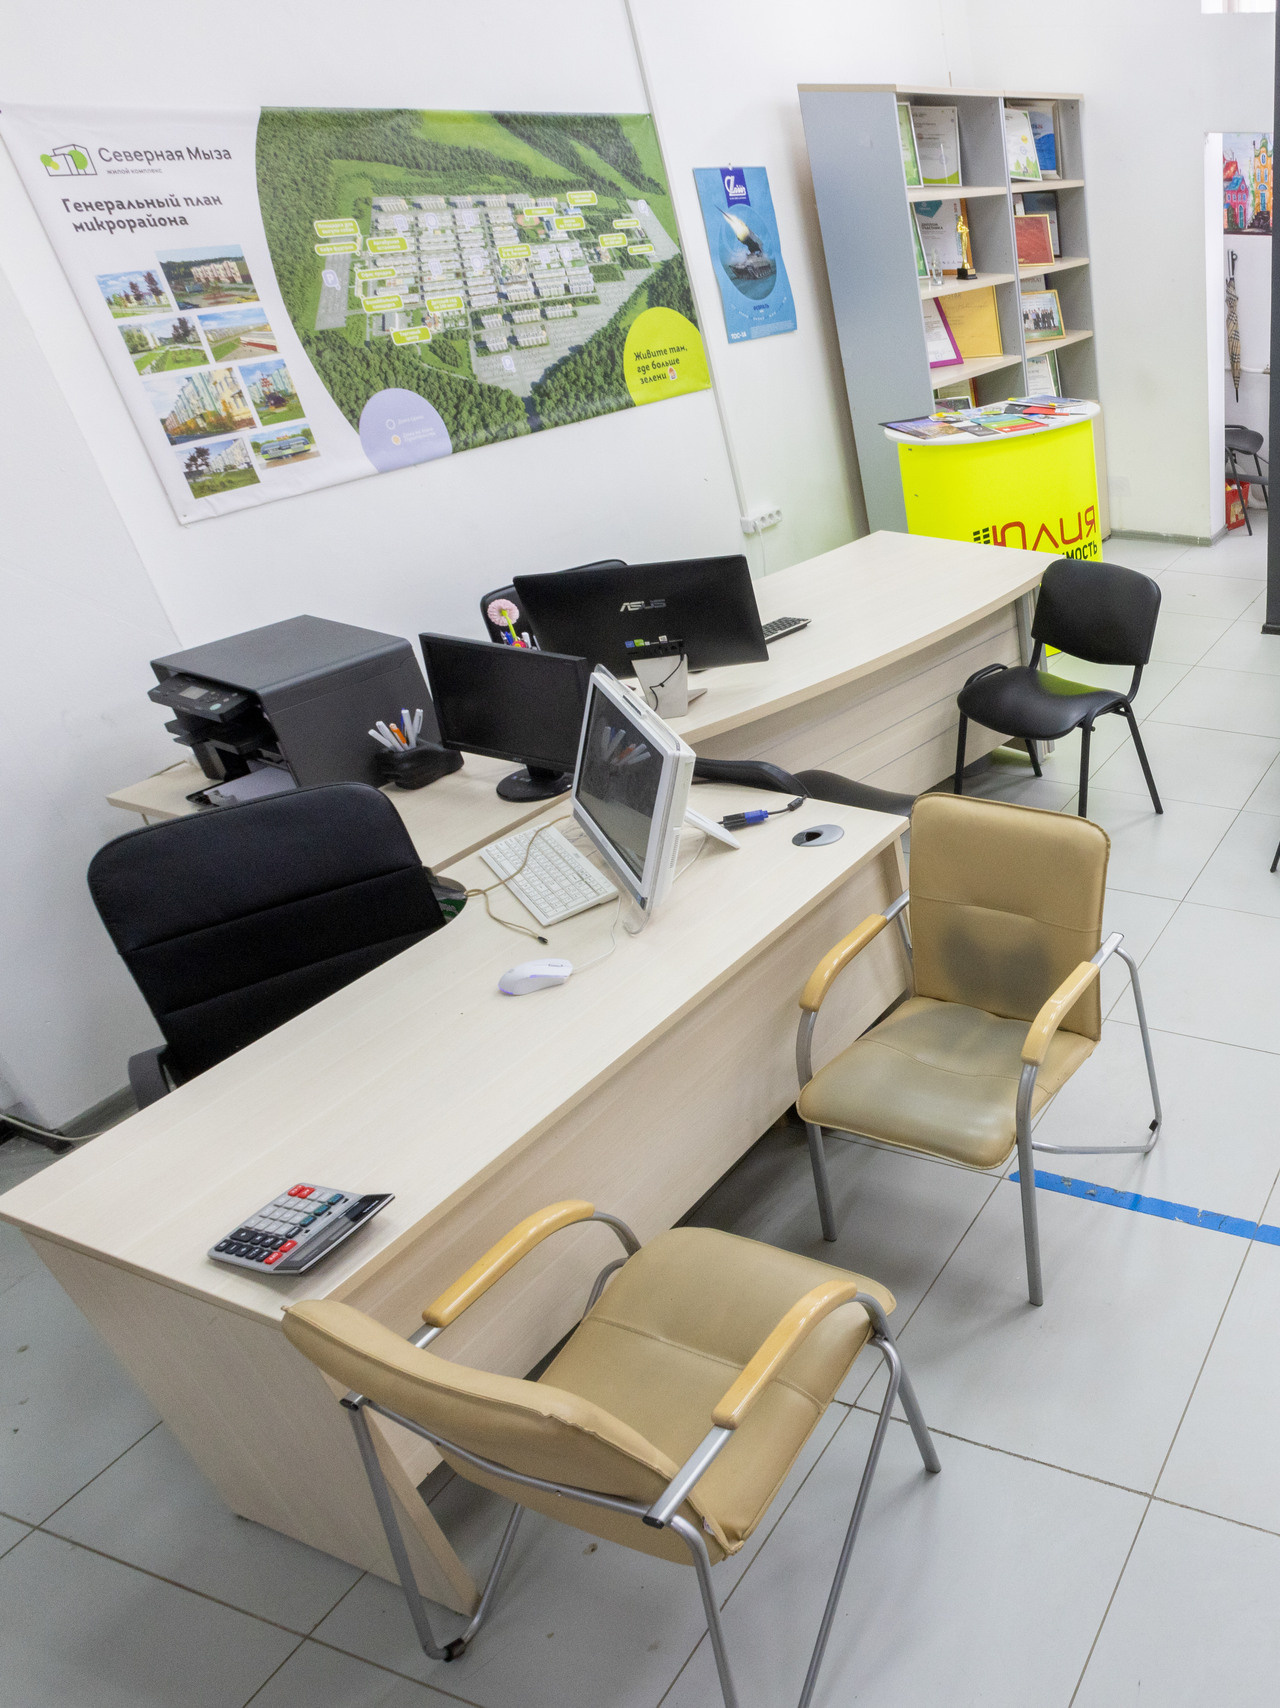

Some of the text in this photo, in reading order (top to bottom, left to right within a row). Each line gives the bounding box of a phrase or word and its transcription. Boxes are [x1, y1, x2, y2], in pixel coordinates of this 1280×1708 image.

[98, 146, 232, 165] Северная Мыза
[106, 167, 163, 175] жилой комплекс
[61, 194, 223, 215] Генеральный план
[72, 213, 189, 234] микрорайона
[634, 345, 688, 361] Живите там,
[637, 358, 680, 375] где больше
[640, 373, 667, 385] зелени
[620, 598, 667, 613] ASUS
